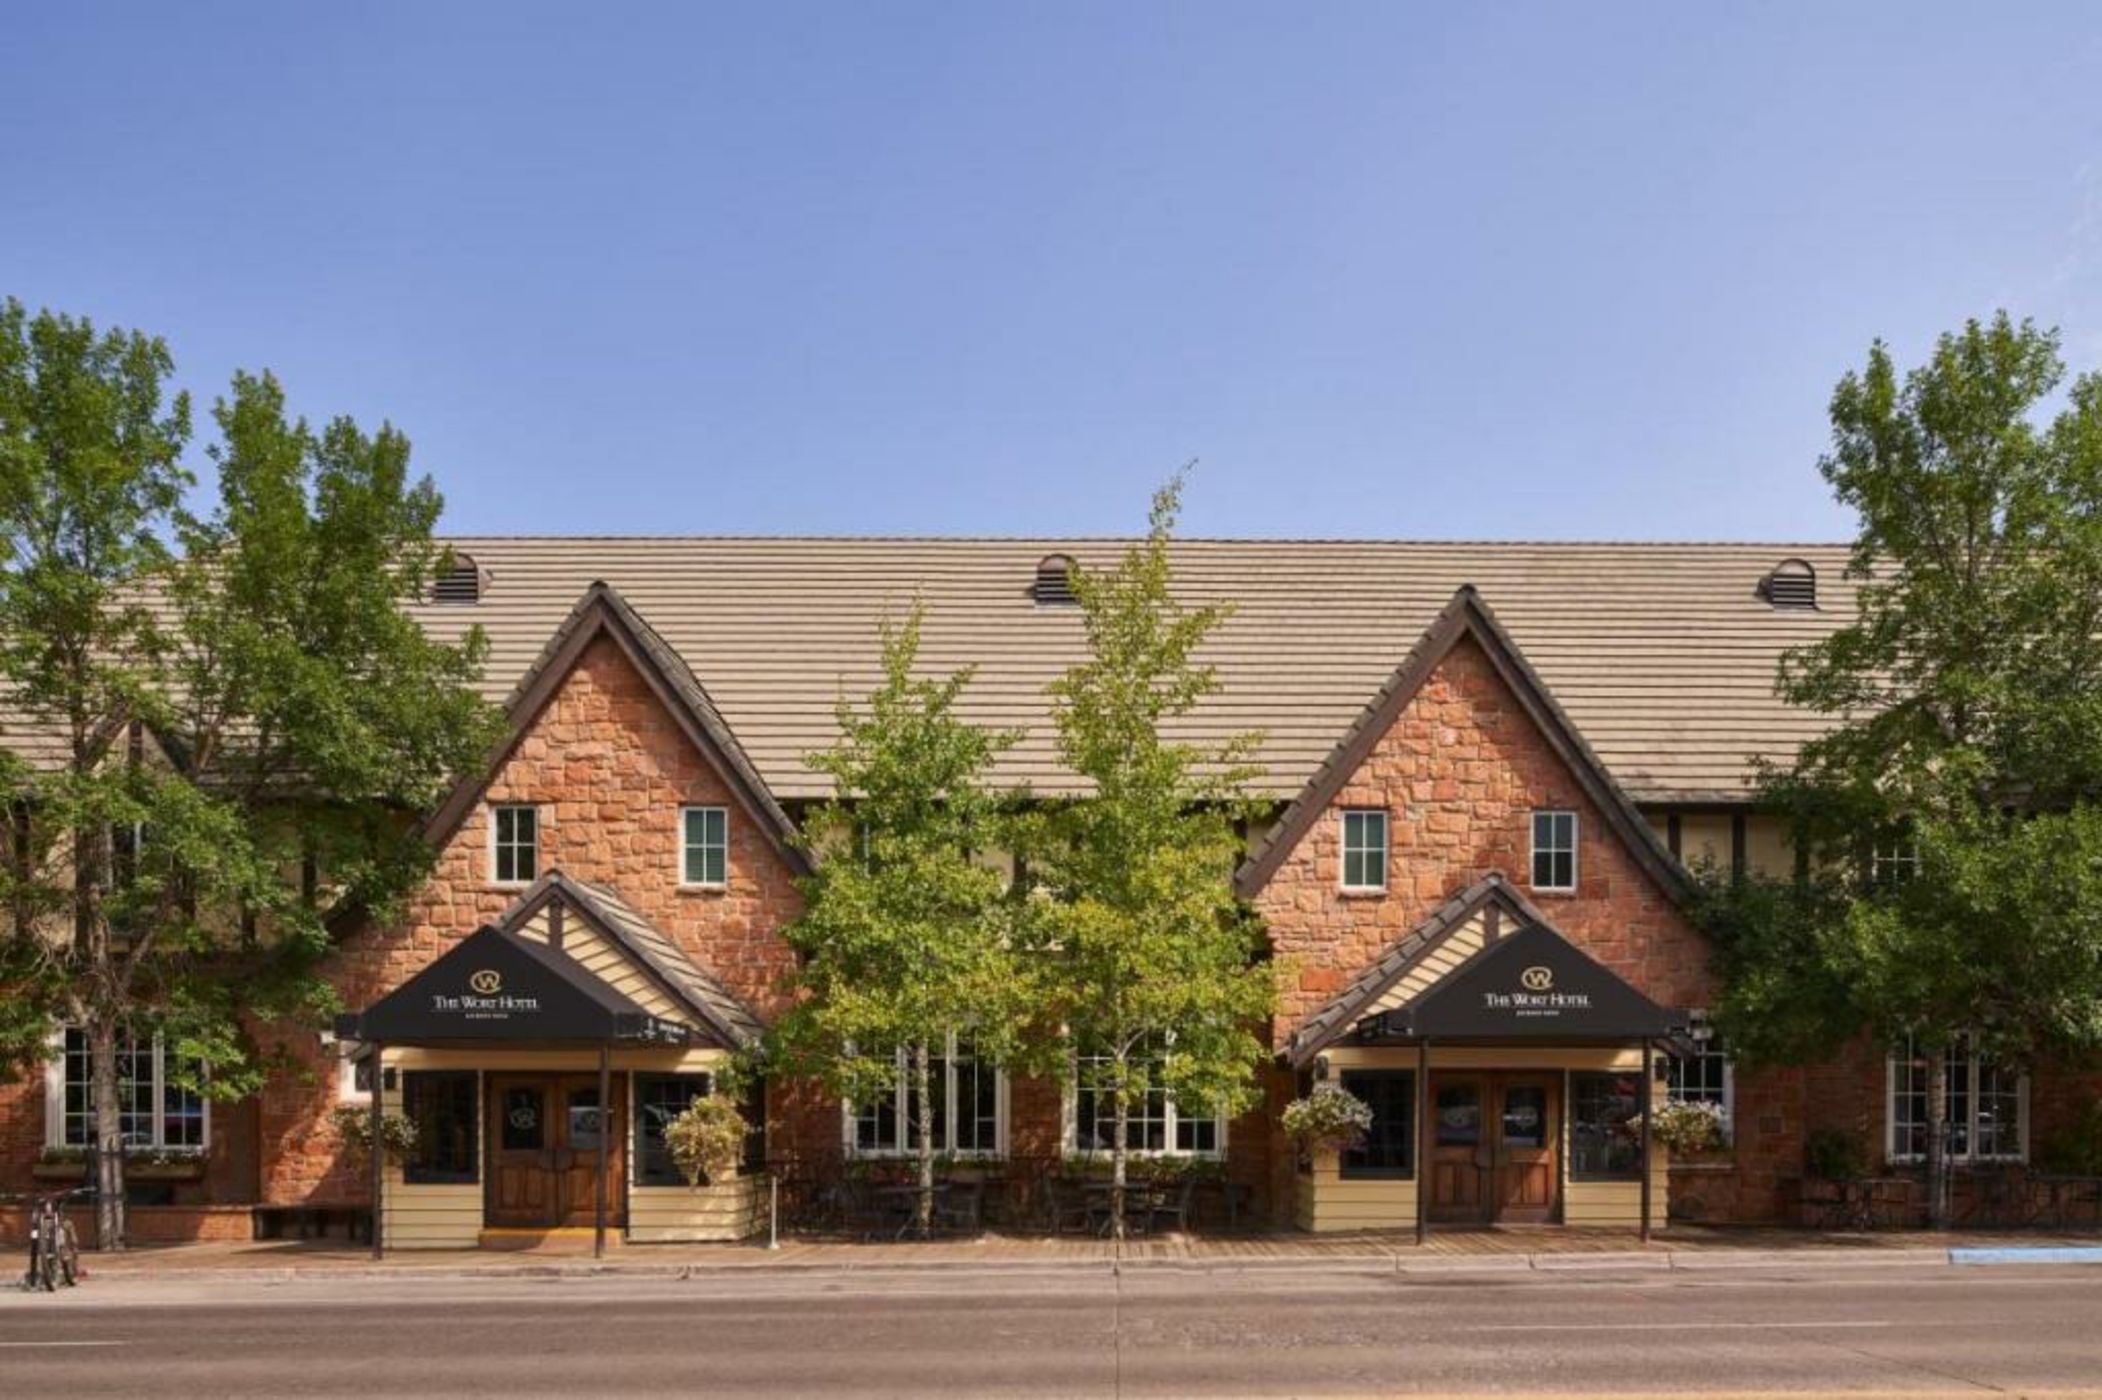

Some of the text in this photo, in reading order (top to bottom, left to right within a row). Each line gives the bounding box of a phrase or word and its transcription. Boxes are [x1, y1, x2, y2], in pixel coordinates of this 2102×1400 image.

[432, 995, 459, 1009] THE
[499, 995, 537, 1009] HOTEL
[1485, 993, 1588, 1007] THE WORT HOTEL
